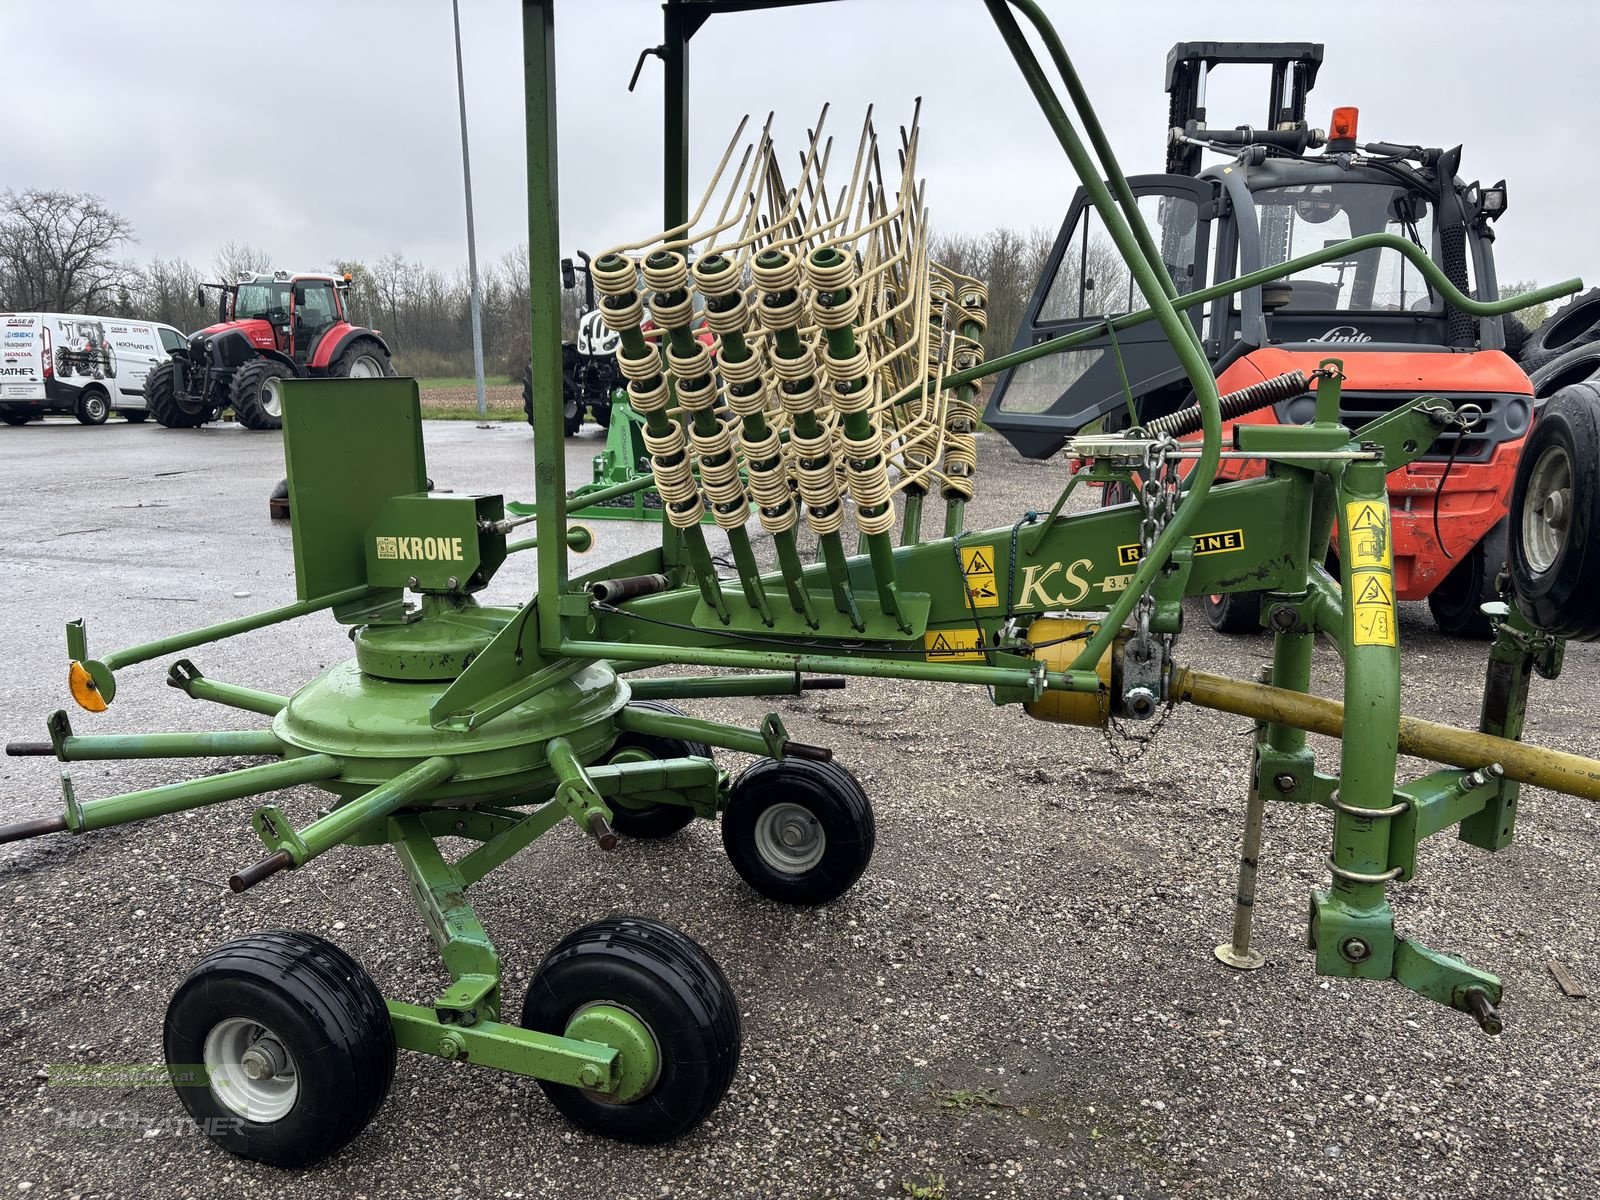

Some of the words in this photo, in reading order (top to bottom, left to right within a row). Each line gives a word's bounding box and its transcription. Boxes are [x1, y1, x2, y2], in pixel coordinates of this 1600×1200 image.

[1306, 325, 1372, 343] Linde
[398, 536, 464, 560] KRONE
[1013, 558, 1094, 609] KS
[1109, 576, 1135, 589] 3.4
